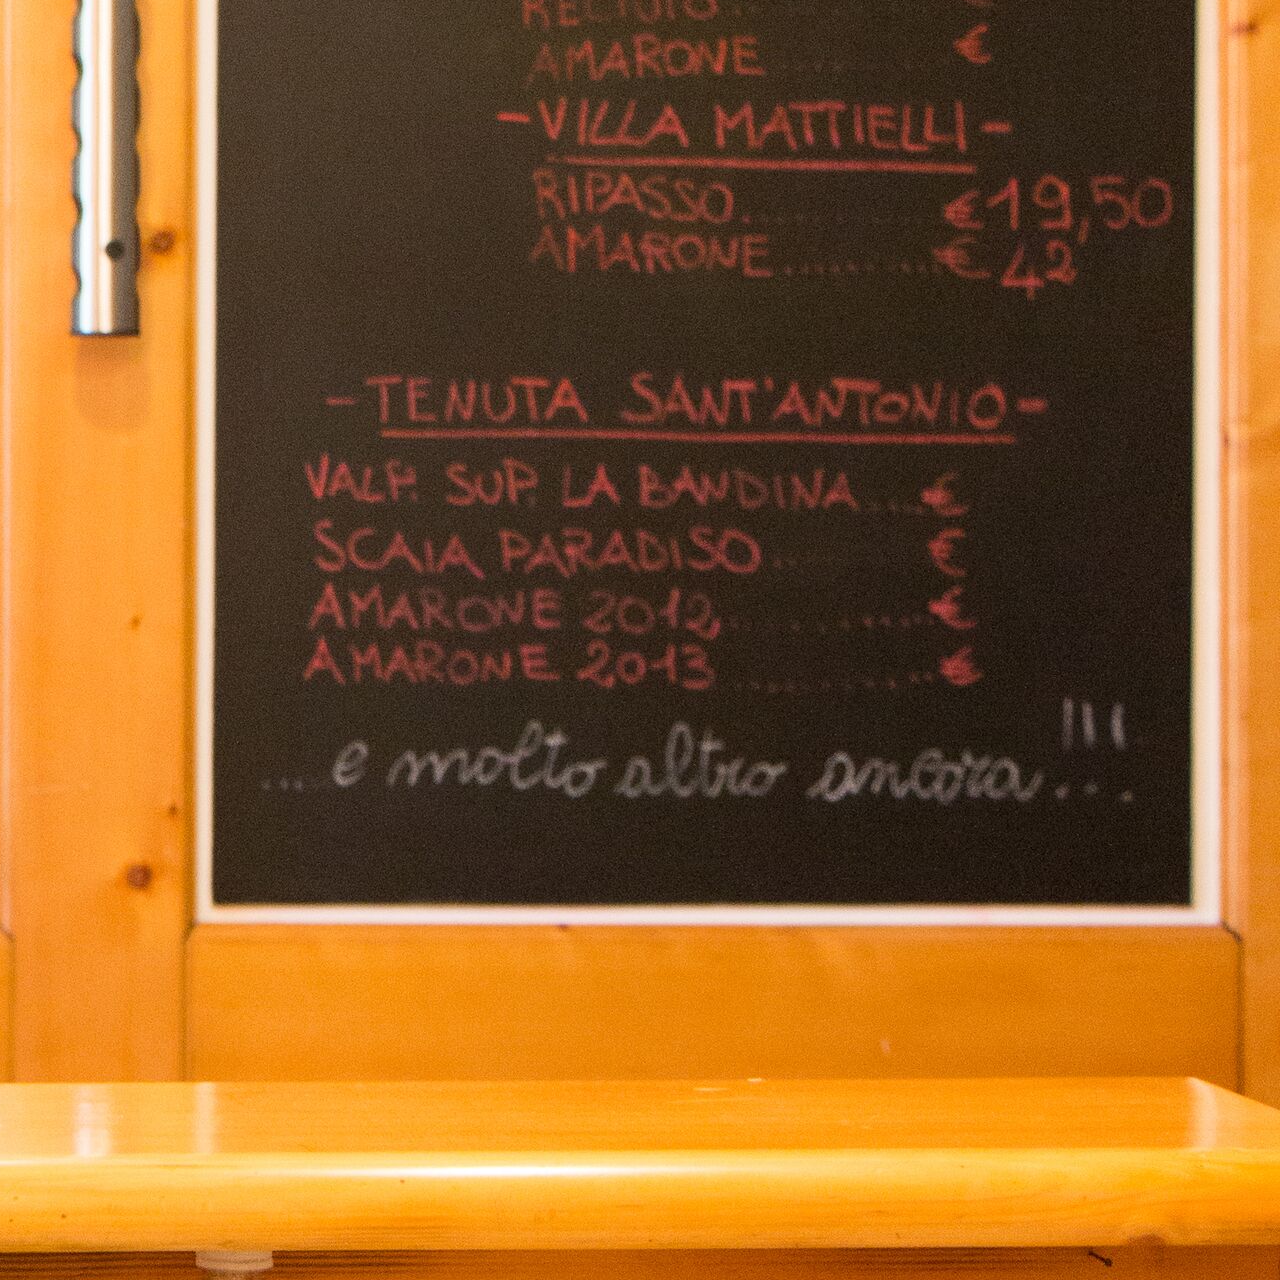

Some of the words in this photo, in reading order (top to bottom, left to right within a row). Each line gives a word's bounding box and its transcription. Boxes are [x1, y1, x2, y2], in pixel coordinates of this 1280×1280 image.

[525, 33, 766, 88] AMARONE
[537, 96, 690, 150] VILLA
[713, 98, 969, 152] MATTIELLI
[533, 168, 735, 224] RIPASSO
[986, 175, 1174, 246] 19,50
[530, 224, 774, 280] AMARONE
[999, 238, 1078, 301] 42
[365, 372, 589, 424] TENUTA
[622, 370, 1008, 431] SANT'ANTONIO
[562, 463, 620, 508] LA
[638, 463, 860, 510] BANDINA
[314, 519, 485, 580] SCAIA
[498, 526, 762, 578] PARADISO
[308, 582, 561, 632] AMARONE
[583, 586, 721, 640] 2012
[304, 635, 560, 685] AMARONE
[576, 639, 716, 691] 2013
[385, 720, 608, 798] molto
[615, 721, 788, 799] altro
